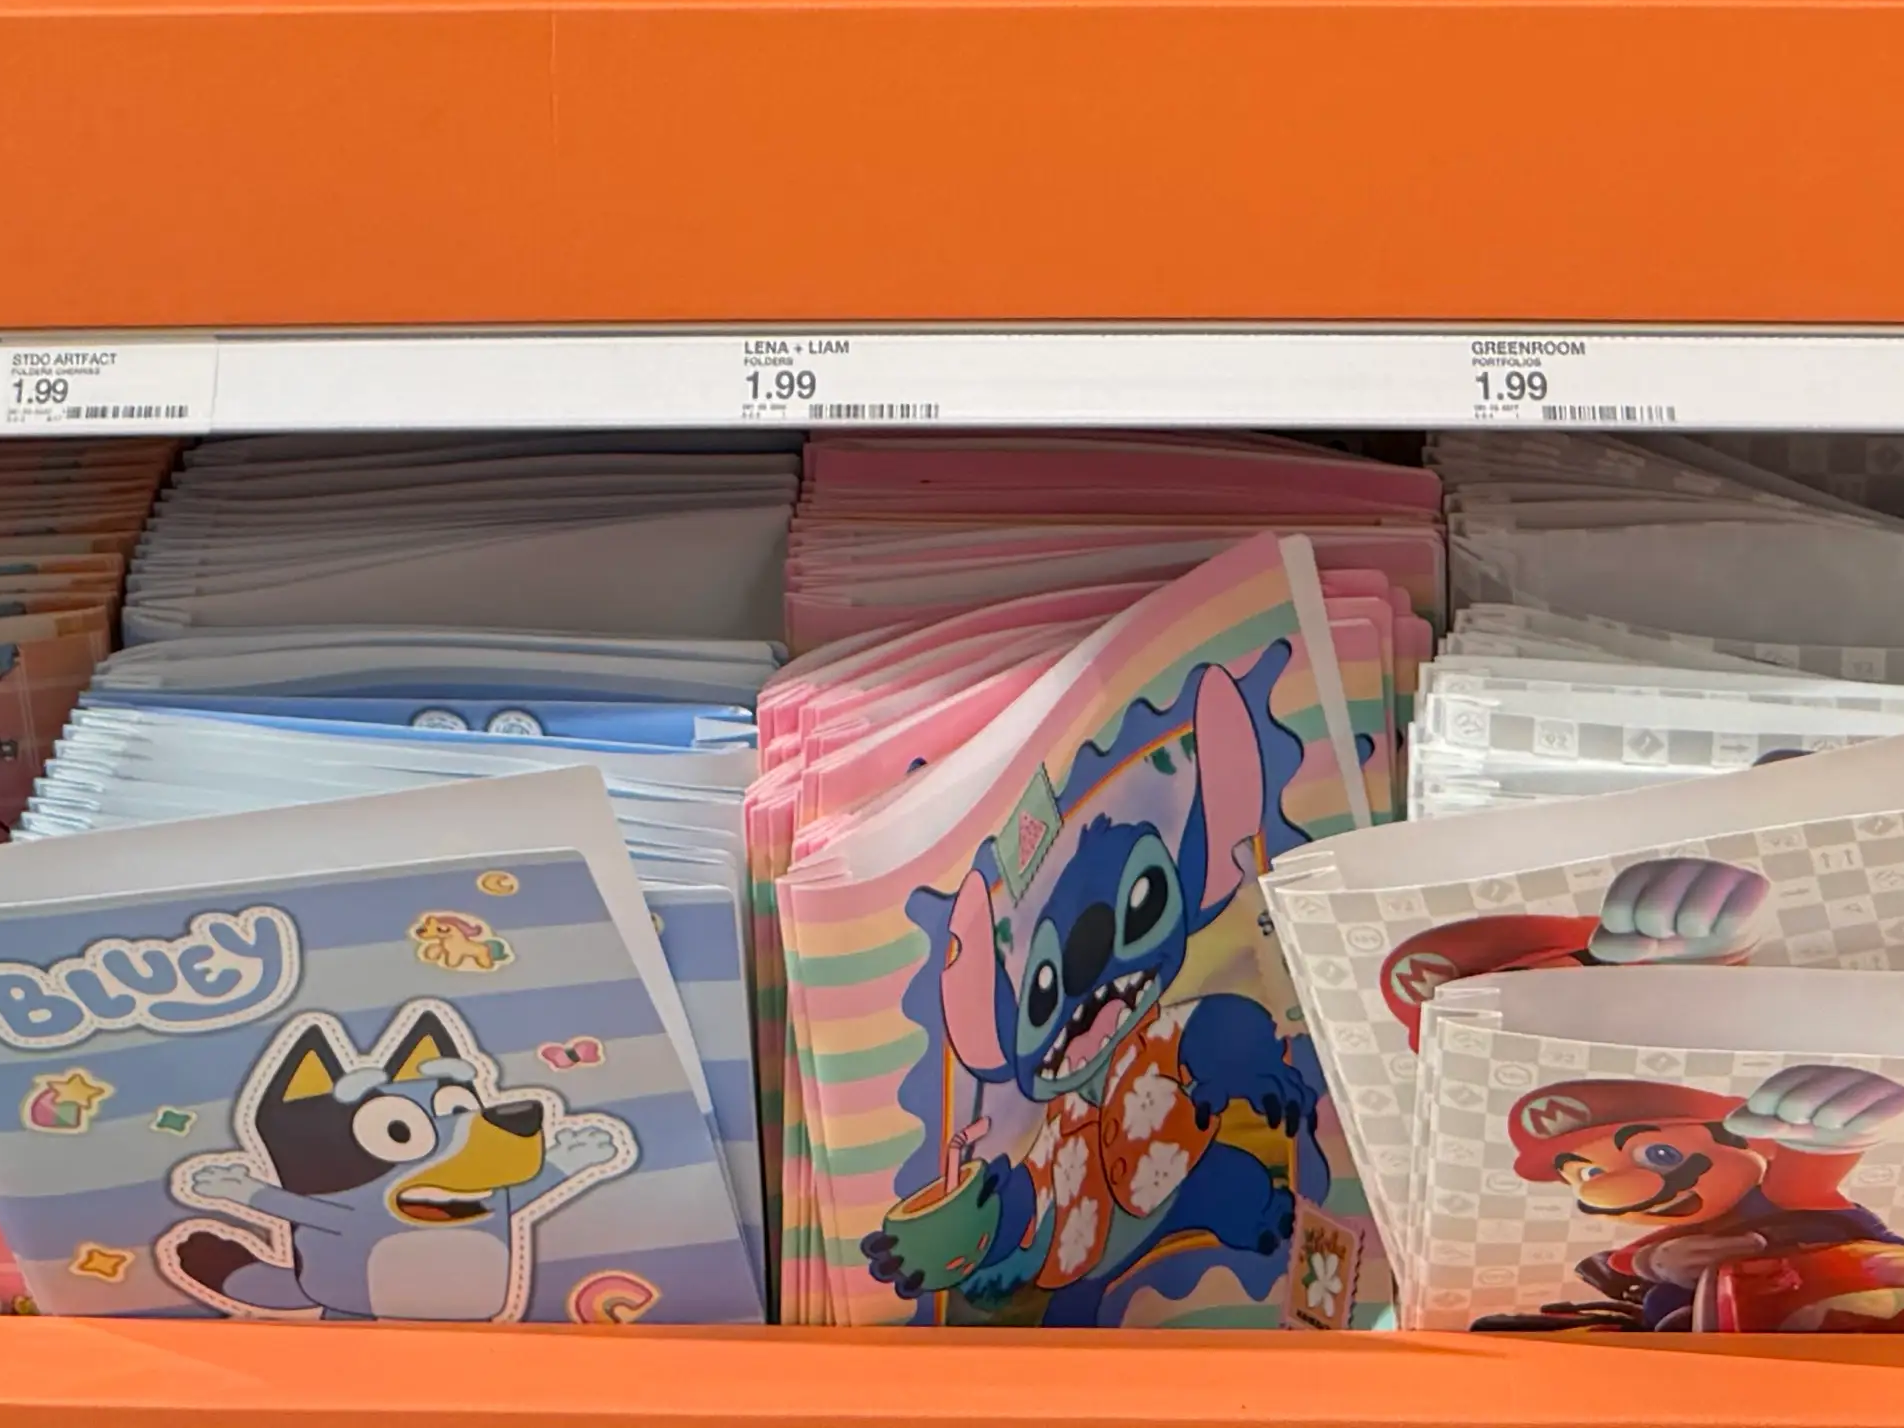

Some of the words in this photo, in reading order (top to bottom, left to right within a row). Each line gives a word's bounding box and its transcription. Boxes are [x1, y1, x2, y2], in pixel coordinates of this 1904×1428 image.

[744, 341, 789, 355] LENA
[809, 341, 849, 354] LIAM
[1472, 341, 1585, 355] GREENROOM
[13, 378, 69, 404] 1.99
[746, 370, 816, 399] 1.99
[1476, 371, 1547, 401] 1.99
